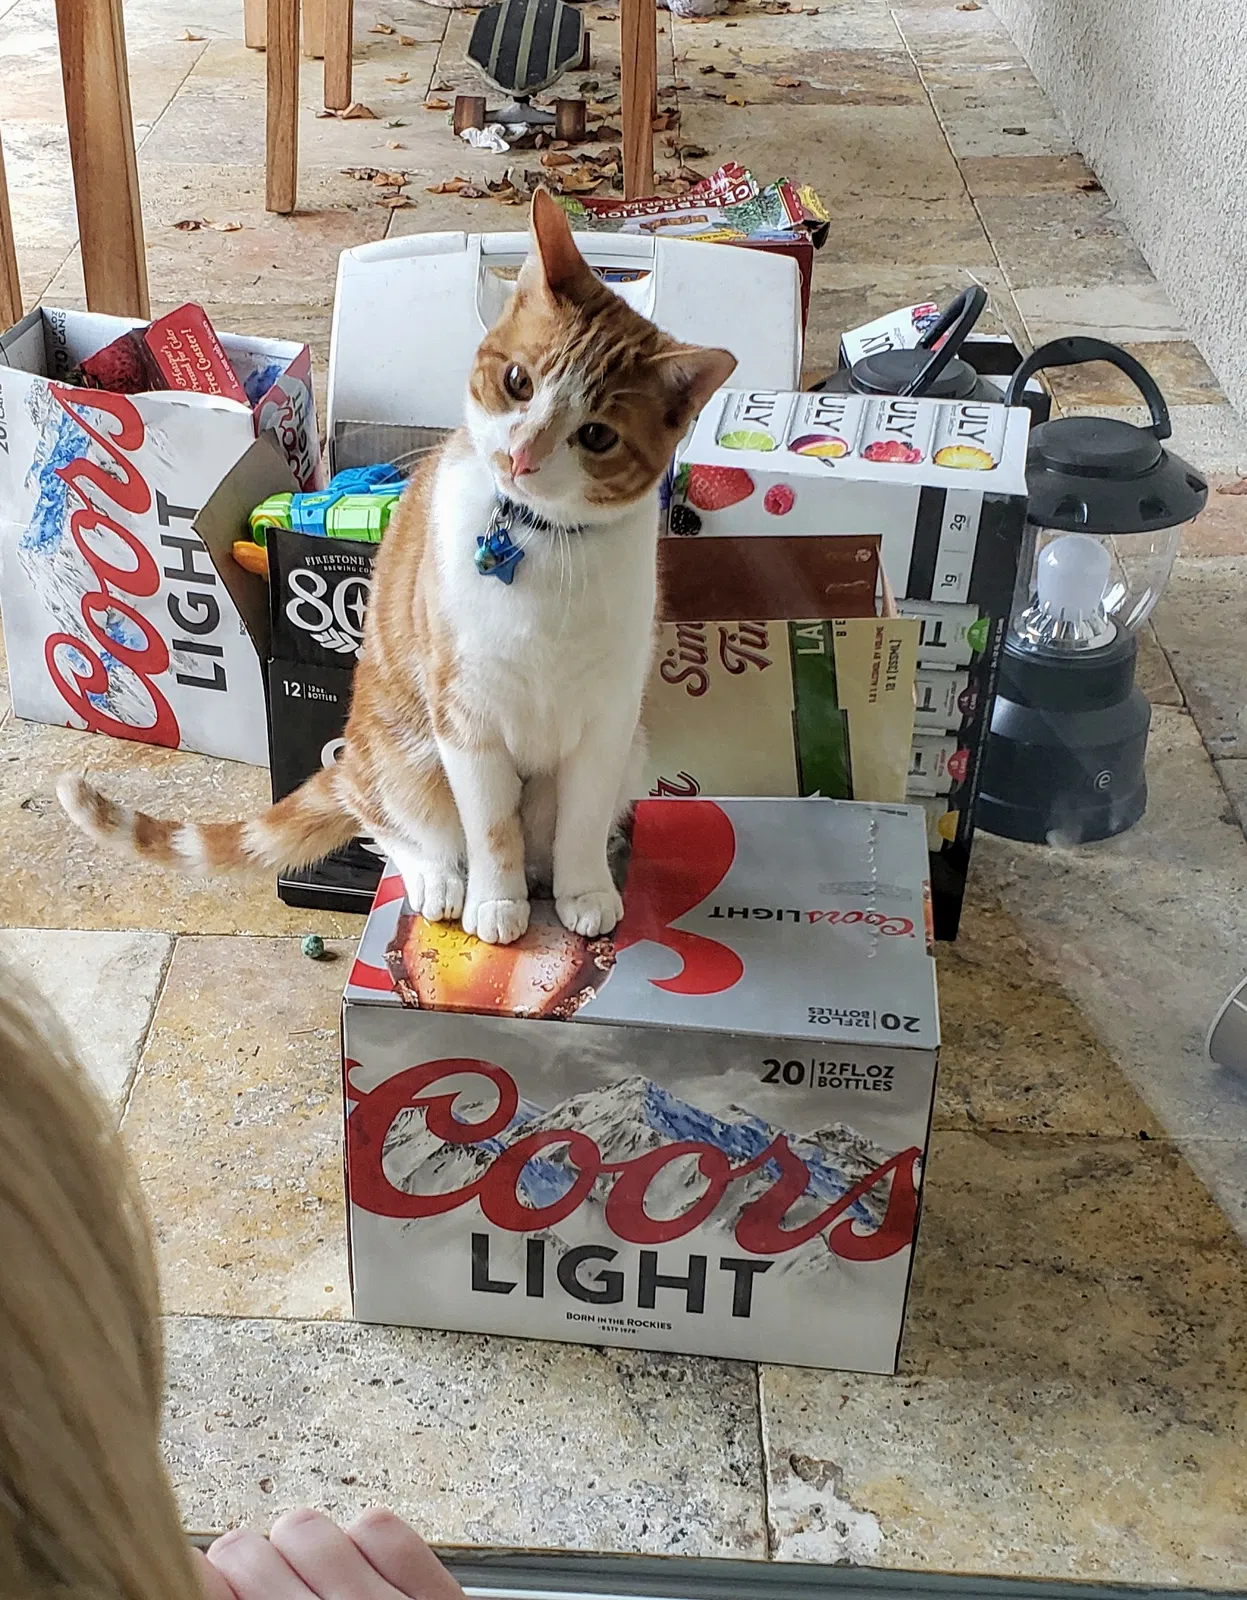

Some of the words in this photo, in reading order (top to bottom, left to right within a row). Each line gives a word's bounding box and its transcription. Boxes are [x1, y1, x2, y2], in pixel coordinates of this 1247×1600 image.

[58, 311, 67, 345] CANS
[180, 328, 211, 371] Coaster!
[204, 371, 222, 395] Free
[292, 390, 311, 477] LIGHT
[949, 514, 967, 532] 2g
[45, 380, 181, 750] Coors
[304, 554, 365, 567] FIRESTONE
[323, 565, 357, 573] BREWING
[155, 488, 229, 692] LIGHT
[282, 680, 302, 697] 12
[307, 691, 338, 703] BOTTLES
[708, 906, 801, 923] LIGHT
[805, 910, 916, 939] Coors
[808, 1006, 870, 1019] BOTTLES
[880, 1012, 921, 1033] 20
[760, 1058, 805, 1085] 20
[817, 1077, 893, 1091] BOTTLES
[345, 1057, 922, 1262] Coors
[470, 1232, 775, 1318] LIGHT
[597, 1316, 608, 1324] IN
[608, 1317, 625, 1326] THE
